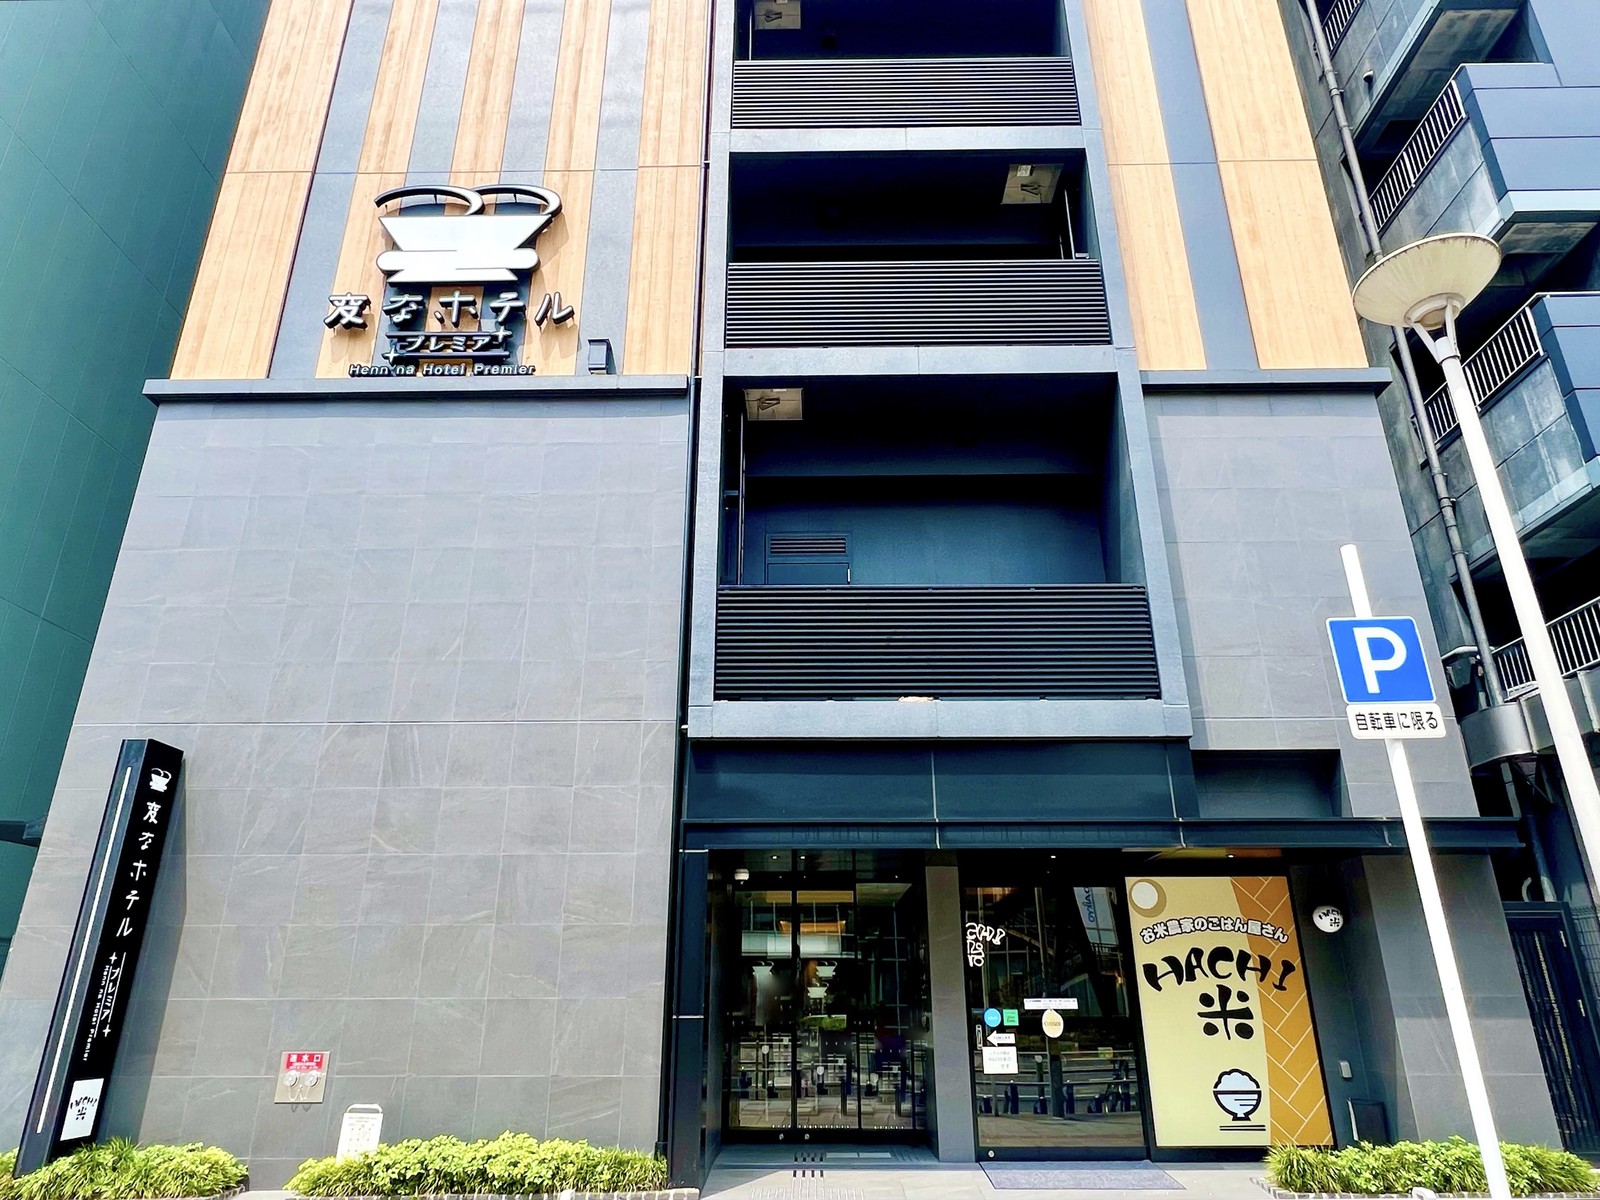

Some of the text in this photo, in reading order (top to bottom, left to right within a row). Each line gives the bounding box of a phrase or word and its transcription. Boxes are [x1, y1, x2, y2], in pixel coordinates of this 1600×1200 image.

[323, 291, 575, 329] 変なホテル
[422, 364, 466, 376] Hotel
[472, 364, 536, 375] Premier
[1352, 626, 1407, 694] P
[1355, 711, 1439, 731] 自転車に限る
[116, 801, 162, 938] 変なホテル
[1142, 946, 1296, 992] HACHI
[91, 1002, 101, 1025] Hotel
[1197, 984, 1254, 1041] 米
[82, 1028, 95, 1061] Premier
